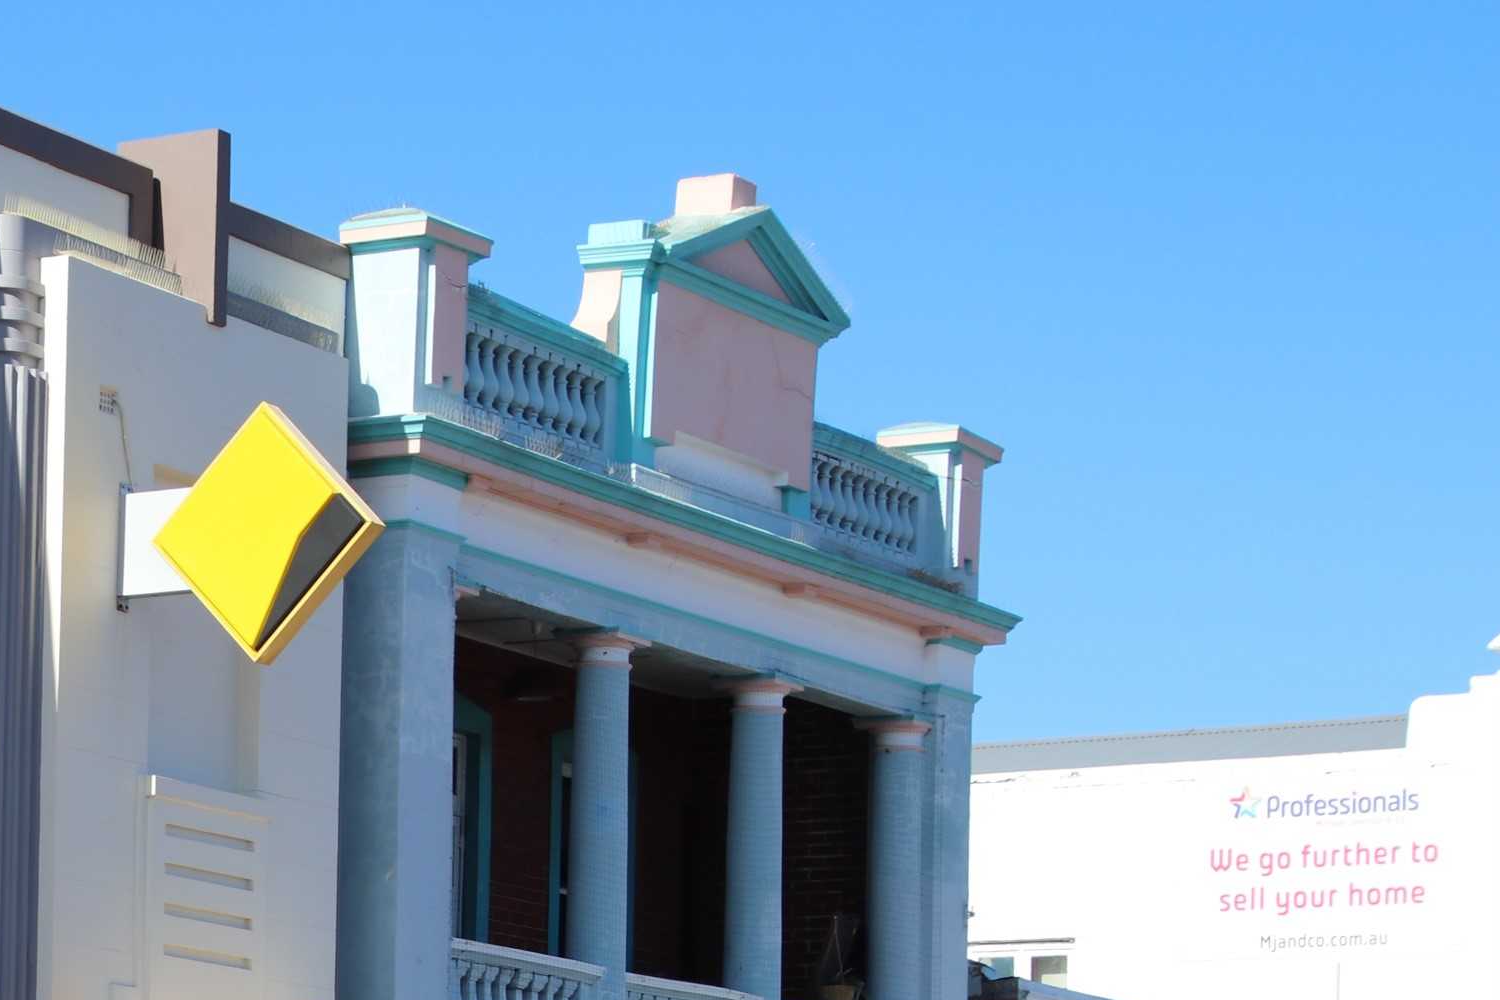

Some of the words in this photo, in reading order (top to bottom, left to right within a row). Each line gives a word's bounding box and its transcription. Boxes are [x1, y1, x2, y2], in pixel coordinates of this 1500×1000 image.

[1267, 788, 1420, 818] Professionals
[1210, 848, 1249, 872] We
[1259, 851, 1291, 876] go
[1301, 842, 1401, 868] further
[1411, 841, 1439, 863] to
[1219, 886, 1264, 912] sell
[1276, 889, 1338, 916] your
[1348, 882, 1425, 906] home
[1260, 932, 1388, 952] Mjandco.com.au
